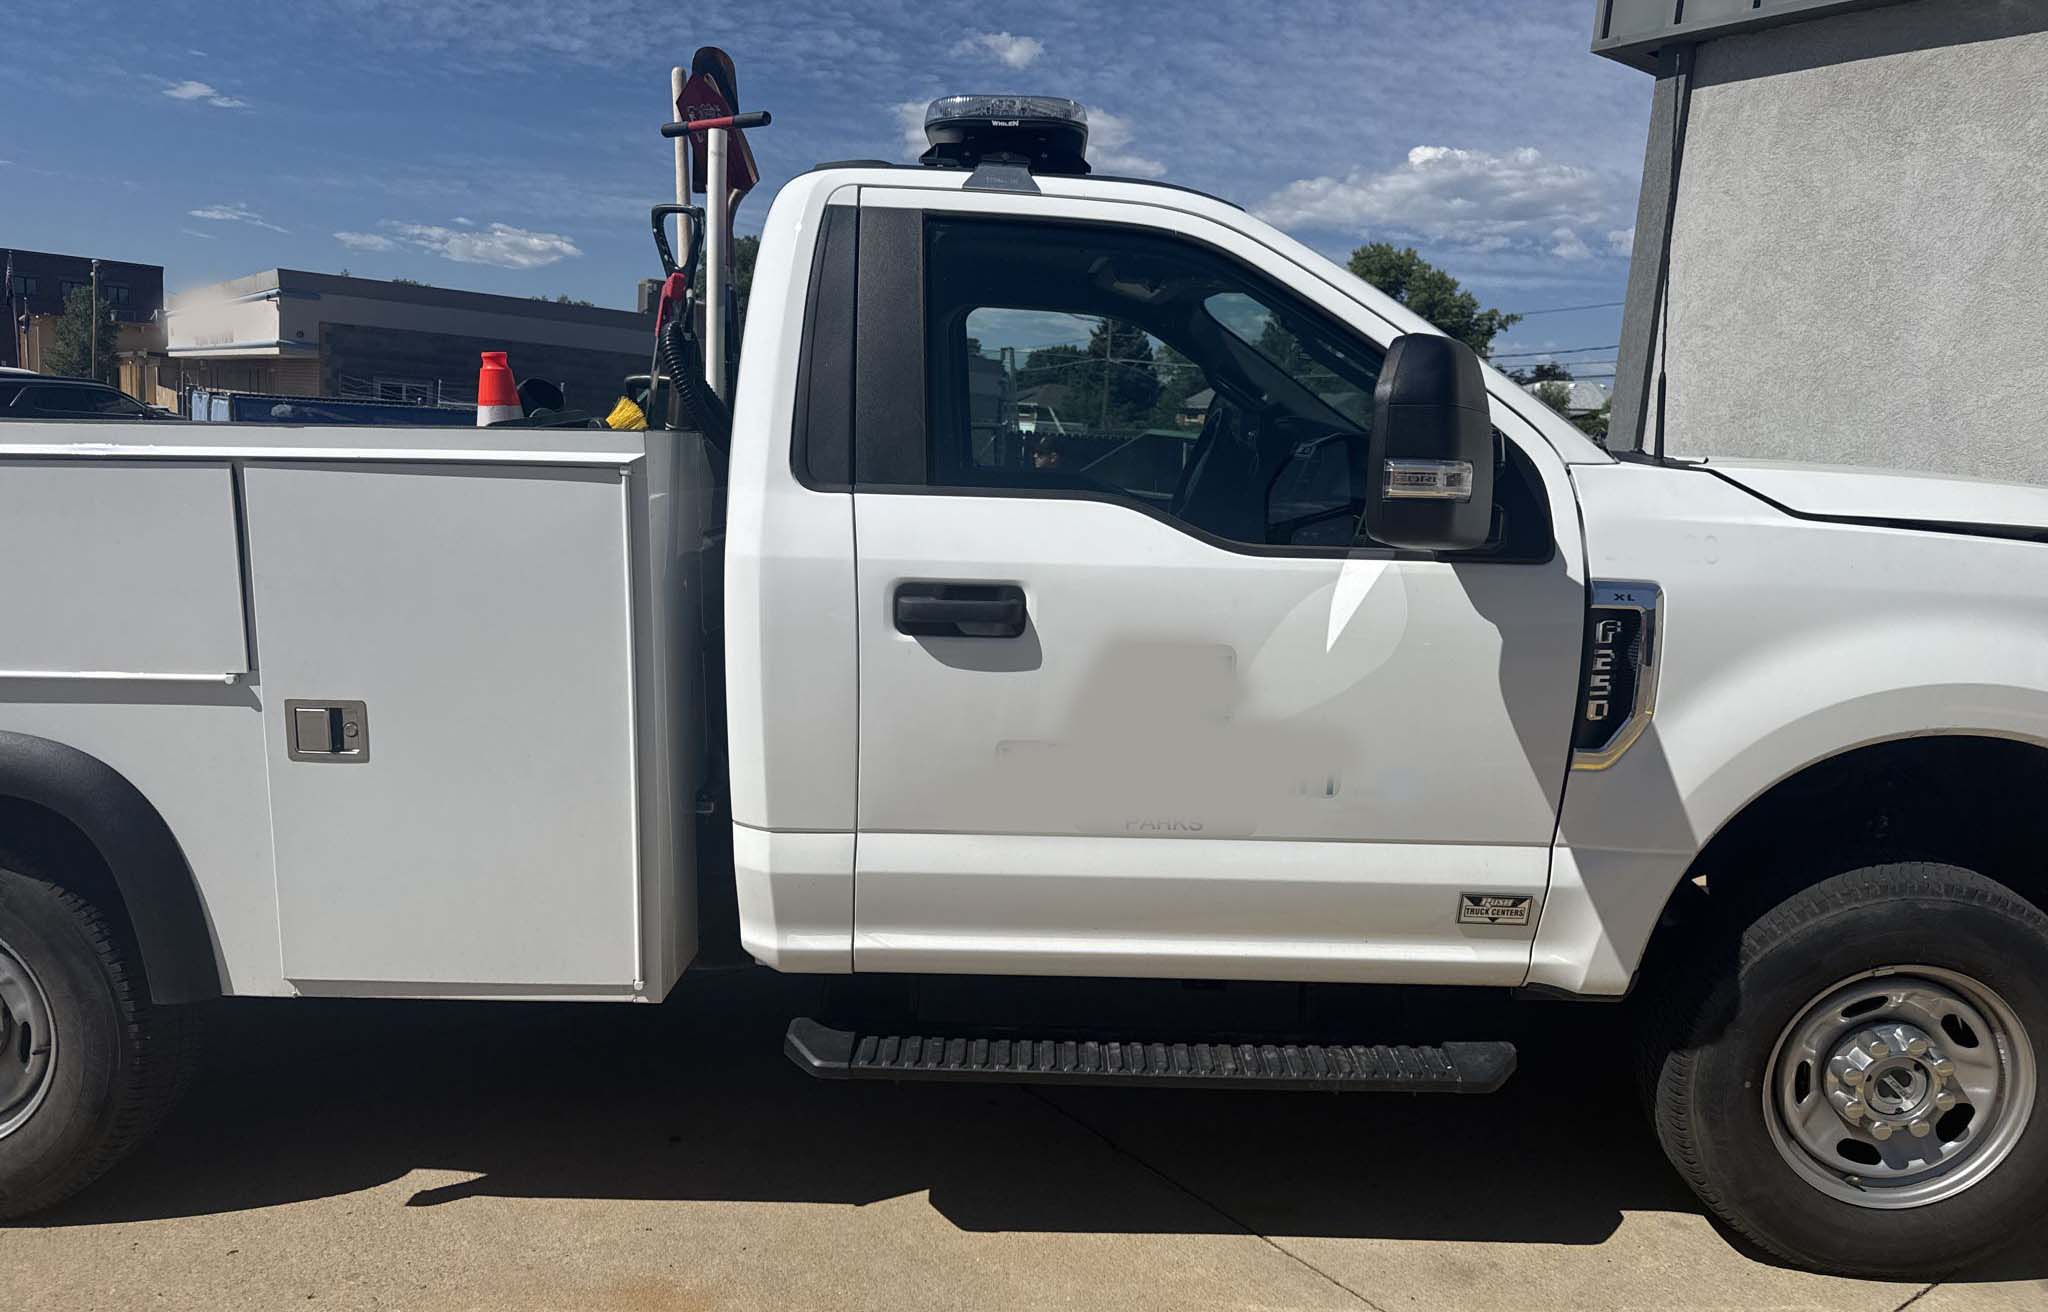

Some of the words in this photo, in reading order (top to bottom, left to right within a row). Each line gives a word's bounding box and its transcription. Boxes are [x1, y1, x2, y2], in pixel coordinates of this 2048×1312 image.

[1613, 593, 1635, 602] XL
[1125, 816, 1204, 832] PARKS
[1466, 907, 1490, 916] TRUCK
[1491, 908, 1525, 918] CENTERS
